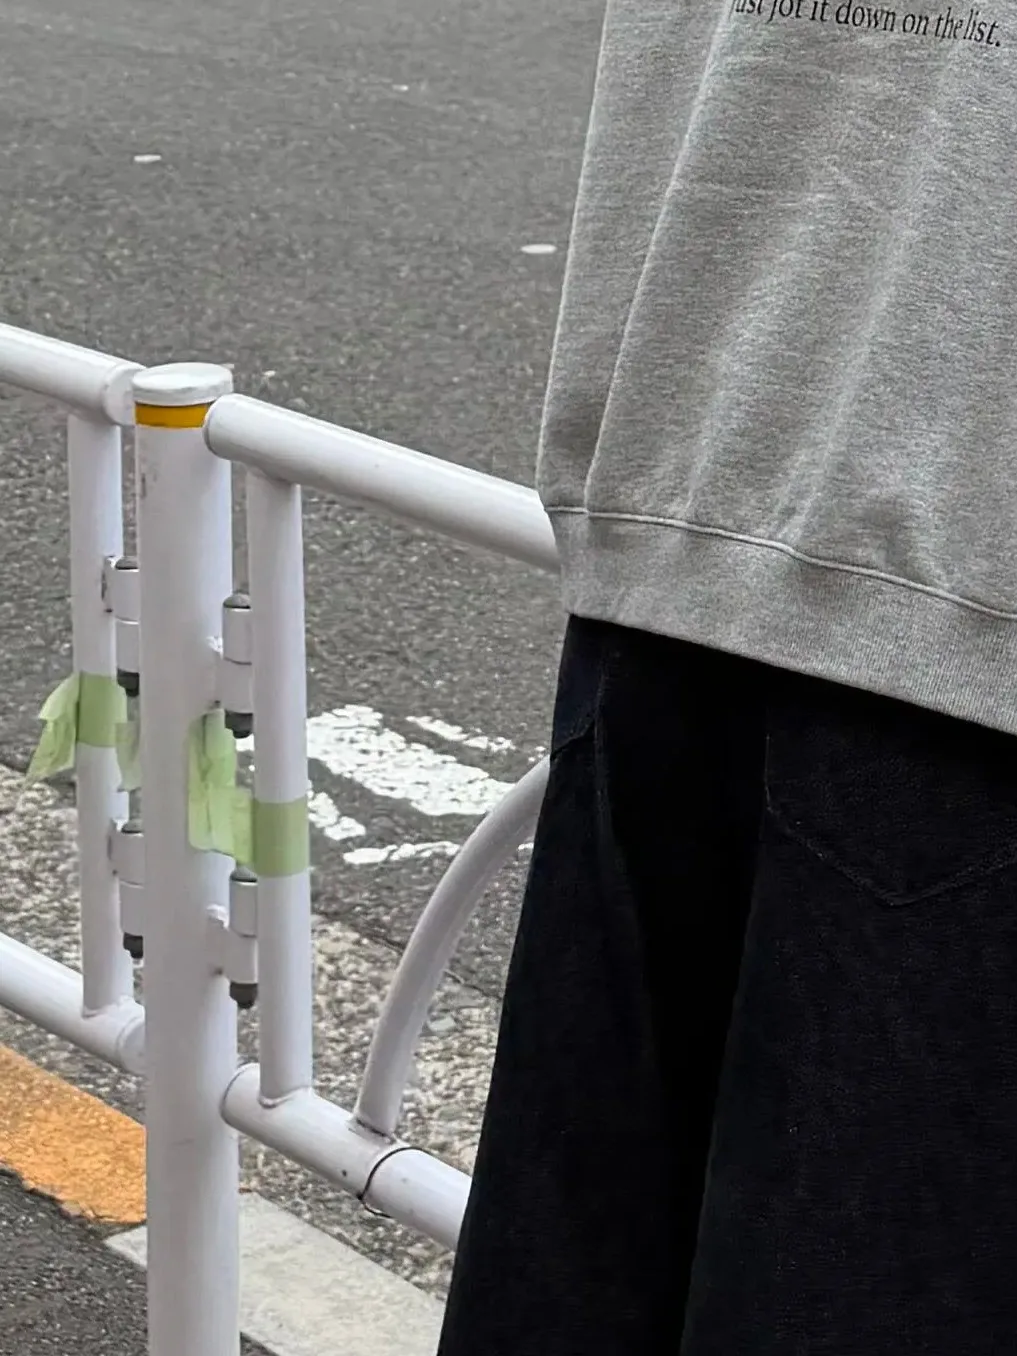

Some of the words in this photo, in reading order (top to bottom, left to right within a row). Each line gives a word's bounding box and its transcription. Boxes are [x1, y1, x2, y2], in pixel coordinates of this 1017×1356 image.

[902, 12, 930, 37] on
[934, 7, 963, 41] the
[962, 9, 1001, 47] list.
